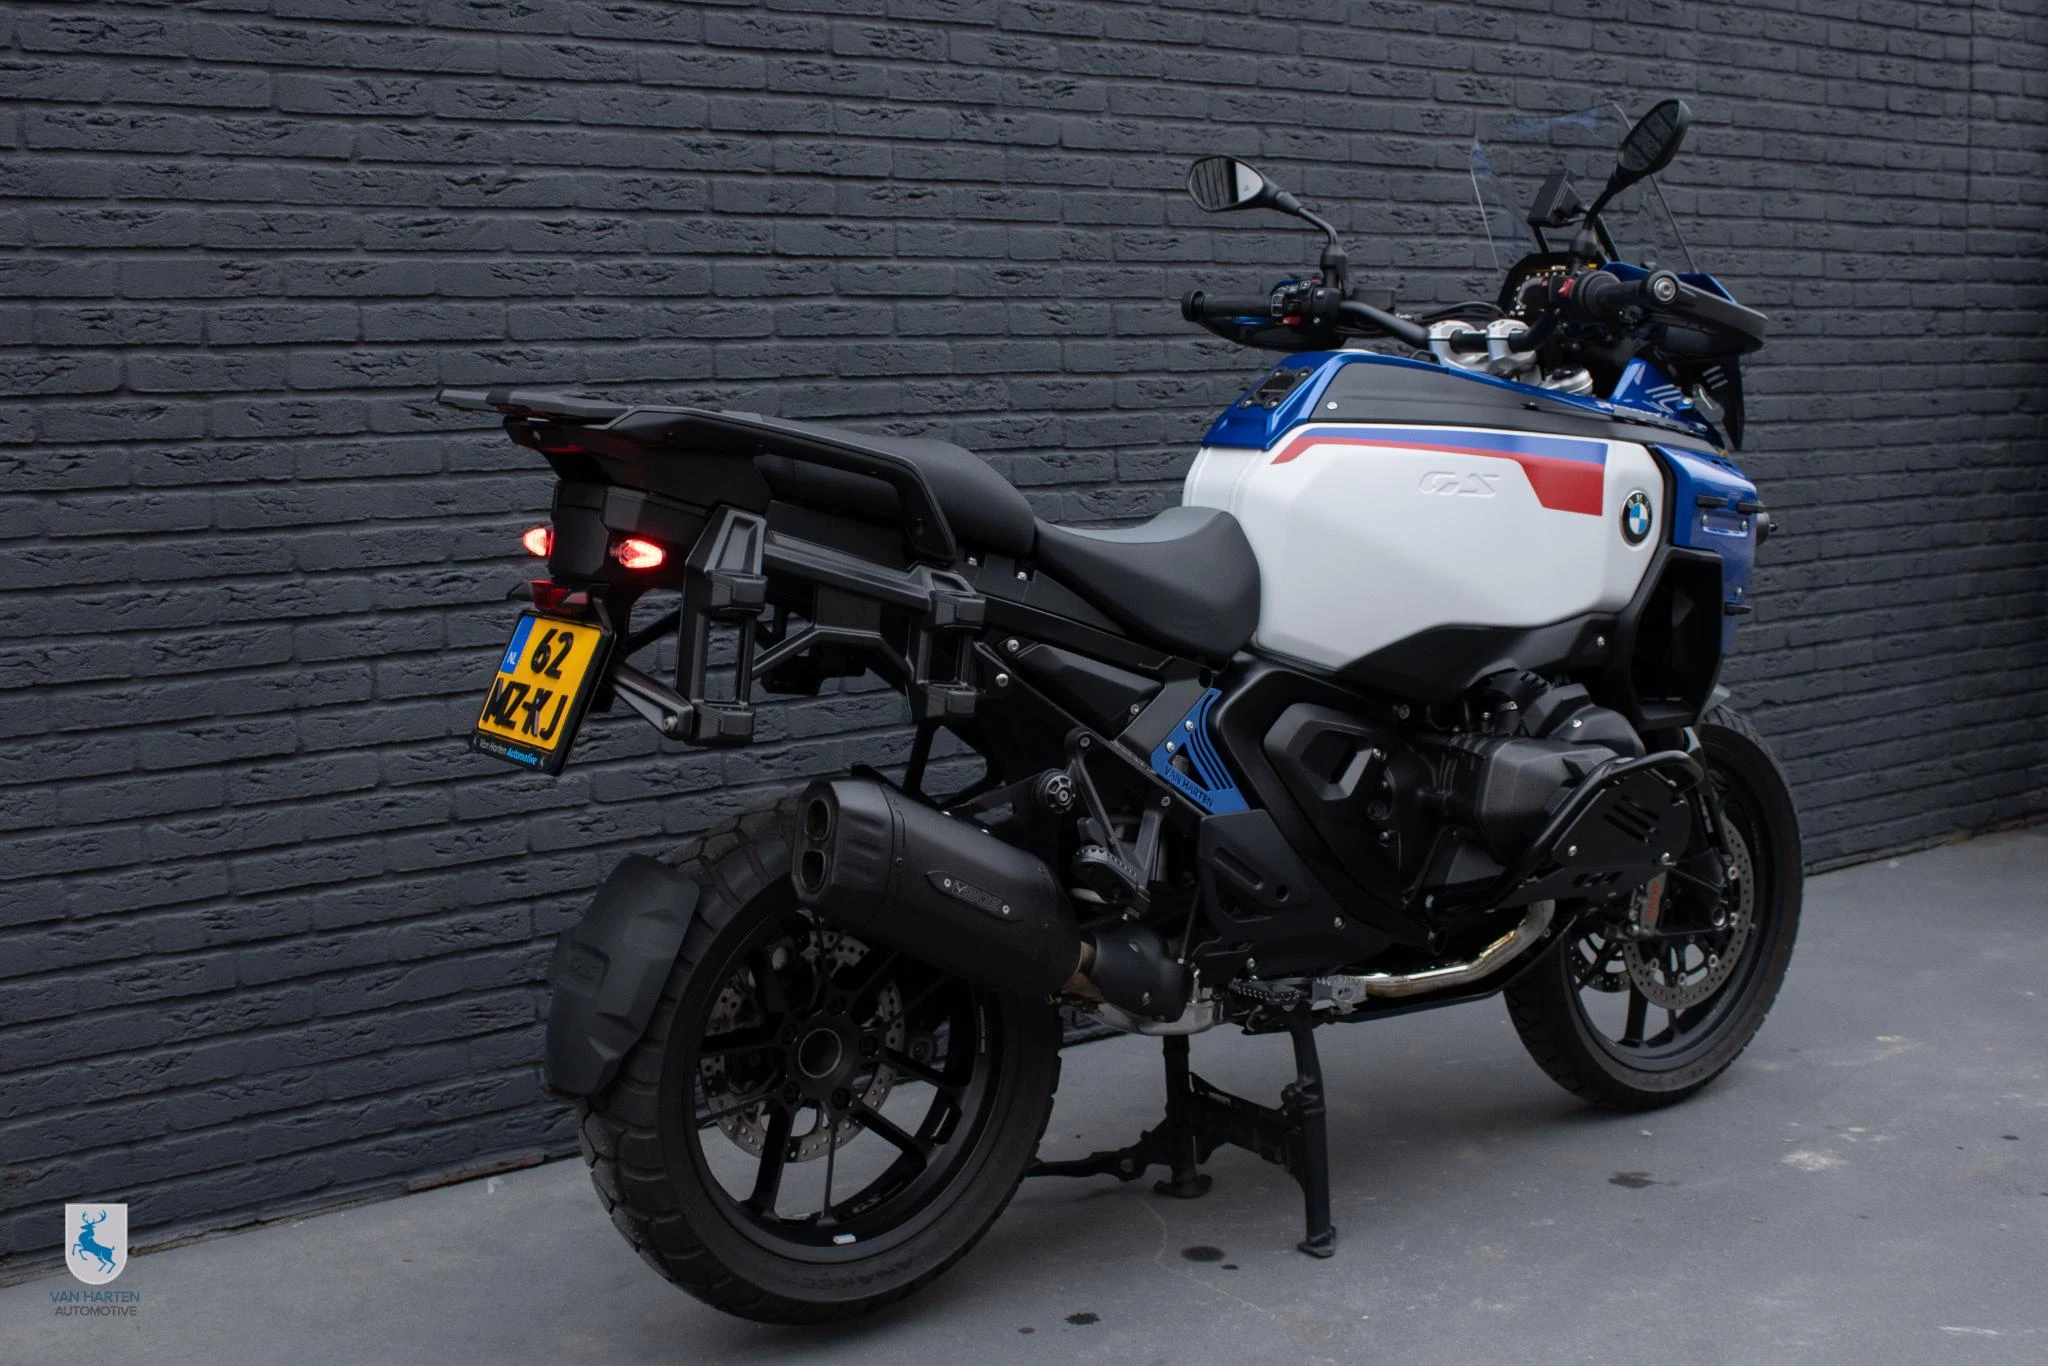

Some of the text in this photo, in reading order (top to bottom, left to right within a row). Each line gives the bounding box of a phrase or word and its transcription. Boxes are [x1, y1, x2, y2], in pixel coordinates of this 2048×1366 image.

[1418, 471, 1501, 498] GS
[506, 651, 516, 665] NL
[530, 628, 575, 680] 62
[481, 677, 569, 741] MZ-KJ
[479, 738, 538, 765] Van Harten Automotive
[1164, 765, 1214, 808] VAN HARTEN
